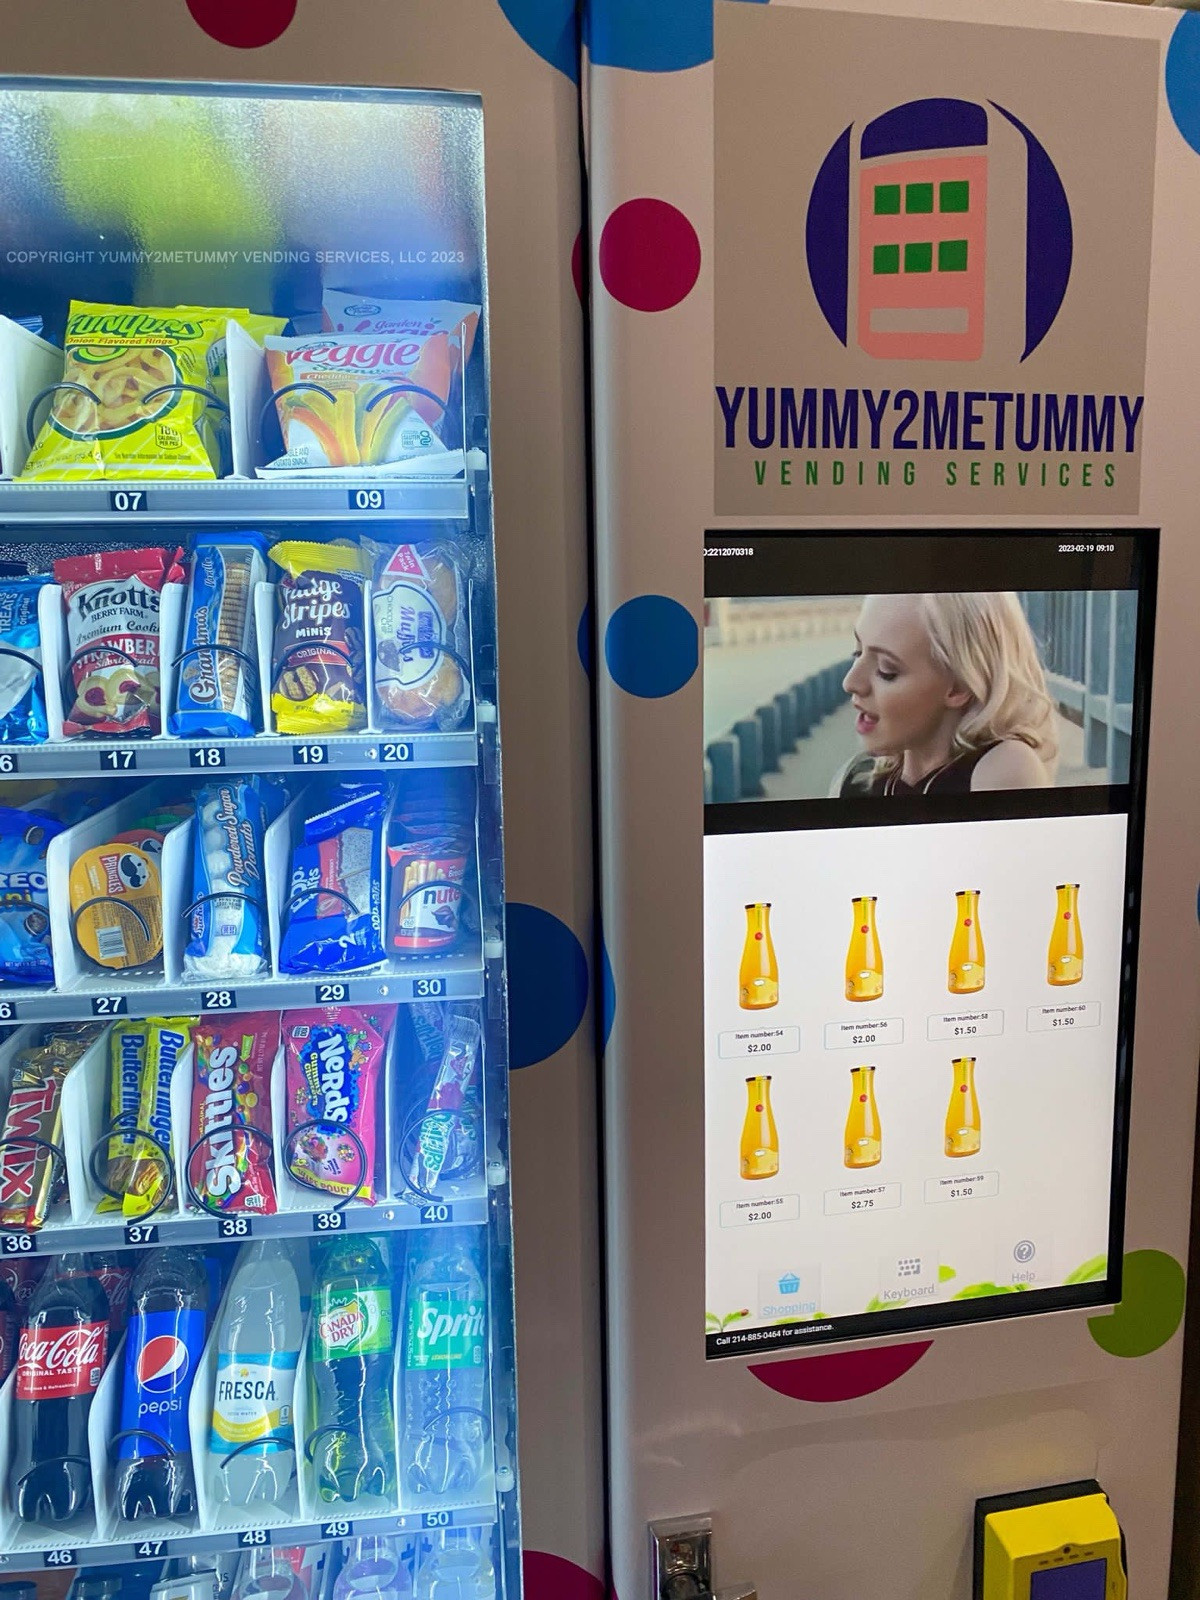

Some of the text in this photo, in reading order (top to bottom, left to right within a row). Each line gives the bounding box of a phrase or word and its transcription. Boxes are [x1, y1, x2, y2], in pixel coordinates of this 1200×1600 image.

[98, 337, 141, 346] Flavored
[144, 337, 173, 346] Rings
[715, 386, 1144, 453] YUMMY2METUMMY
[754, 460, 1117, 488] VENDING SERVICES
[115, 492, 142, 511] 07
[356, 490, 382, 509] 09
[703, 547, 754, 557] D:2212070318
[1058, 544, 1115, 552] 2023-02-19 09:10
[78, 585, 160, 622] Knott's
[91, 607, 144, 622] BERRY FARM
[282, 600, 351, 629] Stripes
[107, 751, 134, 769] 17
[195, 748, 221, 766] 18
[298, 746, 324, 764] 19
[383, 744, 409, 761] 20
[0, 754, 14, 773] 6
[0, 871, 48, 891] REO
[101, 855, 124, 894] PRINGLES
[319, 985, 345, 1001] 29
[417, 979, 442, 995] 30
[96, 997, 122, 1014] 27
[205, 991, 232, 1008] 28
[0, 1003, 12, 1018] 6
[1052, 1017, 1075, 1026] $1.50
[954, 1026, 977, 1036] $1.50
[852, 1035, 876, 1044] $2.00
[747, 1043, 772, 1053] $2.00
[950, 1187, 973, 1198] $1.50
[851, 1200, 874, 1210] $2.75
[317, 1214, 342, 1229] 39
[424, 1206, 448, 1221] 40
[748, 1211, 772, 1222] $2.00
[129, 1226, 154, 1242] 37
[223, 1219, 248, 1235] 38
[6, 1235, 32, 1252] 36
[1011, 1270, 1036, 1284] Help
[883, 1283, 935, 1300] Keyboard
[762, 1301, 816, 1317] Shopping
[331, 1324, 355, 1343] DRY
[716, 1323, 835, 1346] Call 214-885-0464 for assistance.
[19, 1326, 103, 1370] Coca-Cola
[218, 1380, 276, 1402] FRESCA
[138, 1396, 182, 1419] pepsi
[426, 1511, 450, 1527] 50
[325, 1520, 350, 1537] 49
[242, 1530, 267, 1546] 48
[138, 1540, 164, 1556] 47
[47, 1549, 73, 1565] 46
